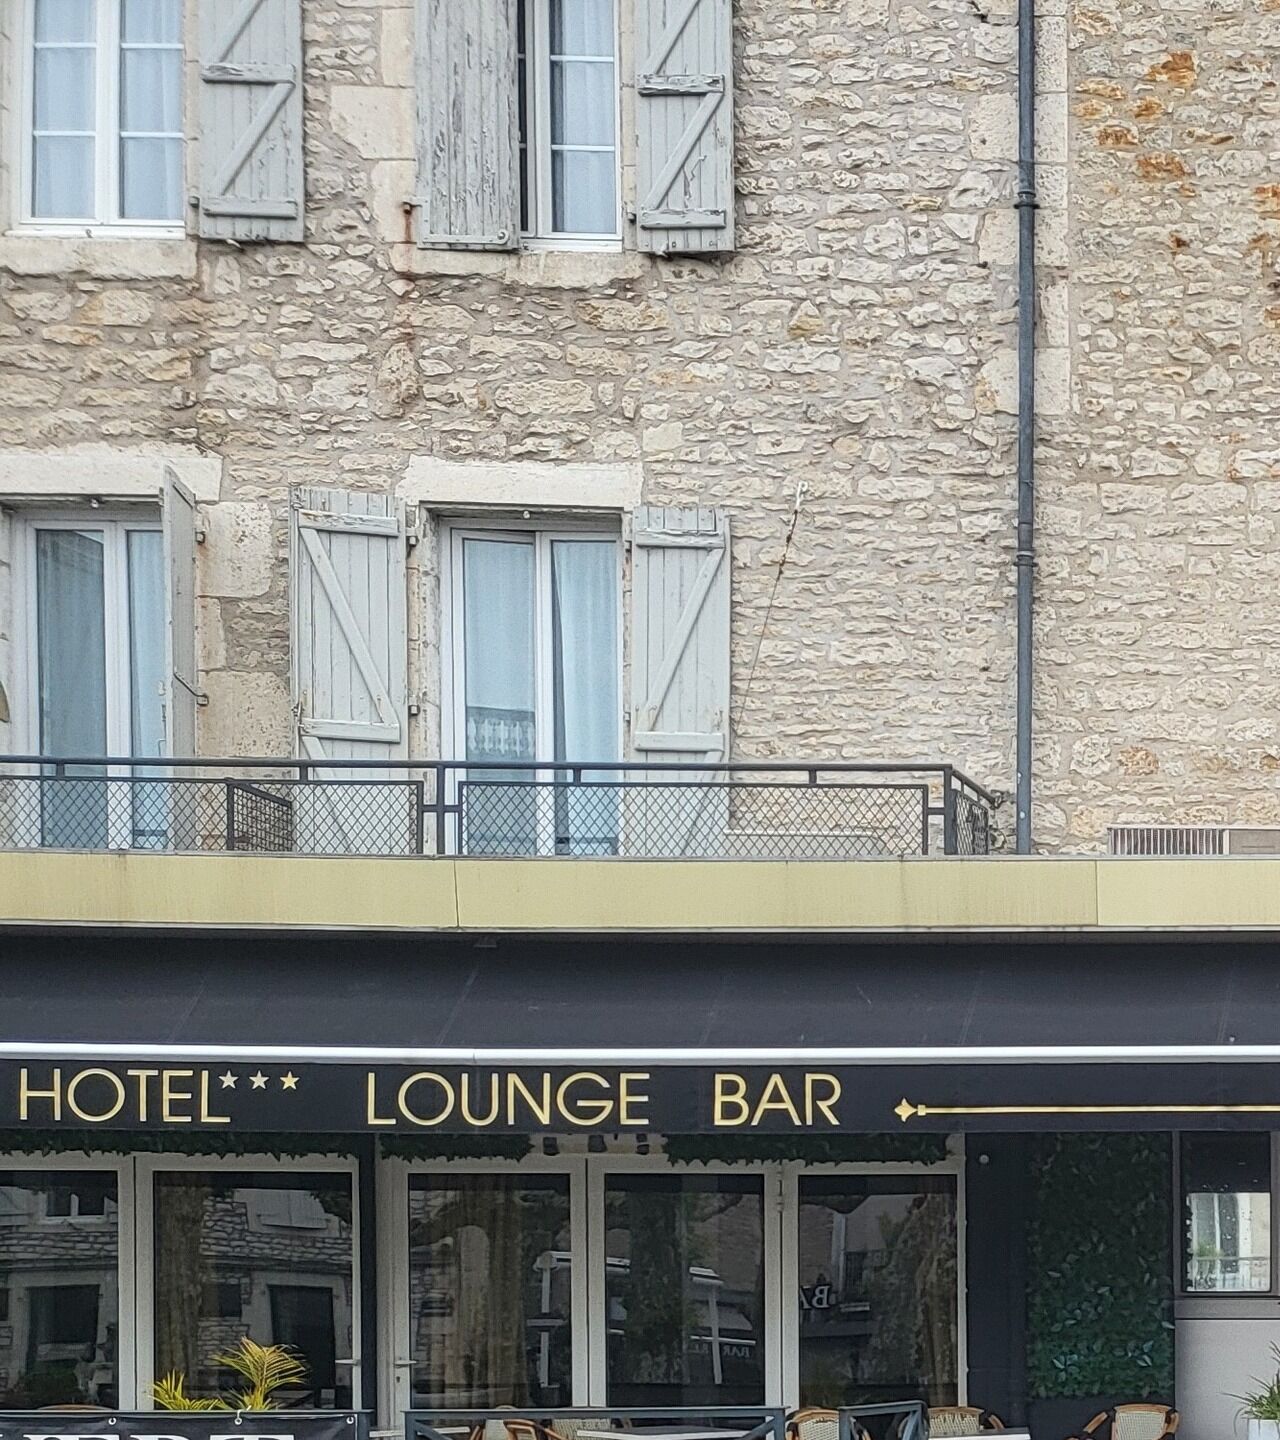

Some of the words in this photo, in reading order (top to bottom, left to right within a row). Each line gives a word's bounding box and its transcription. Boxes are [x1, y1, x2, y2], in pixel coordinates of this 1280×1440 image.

[19, 1067, 231, 1123] HOTEL
[367, 1072, 651, 1126] LOUNGE
[714, 1073, 842, 1127] BAR
